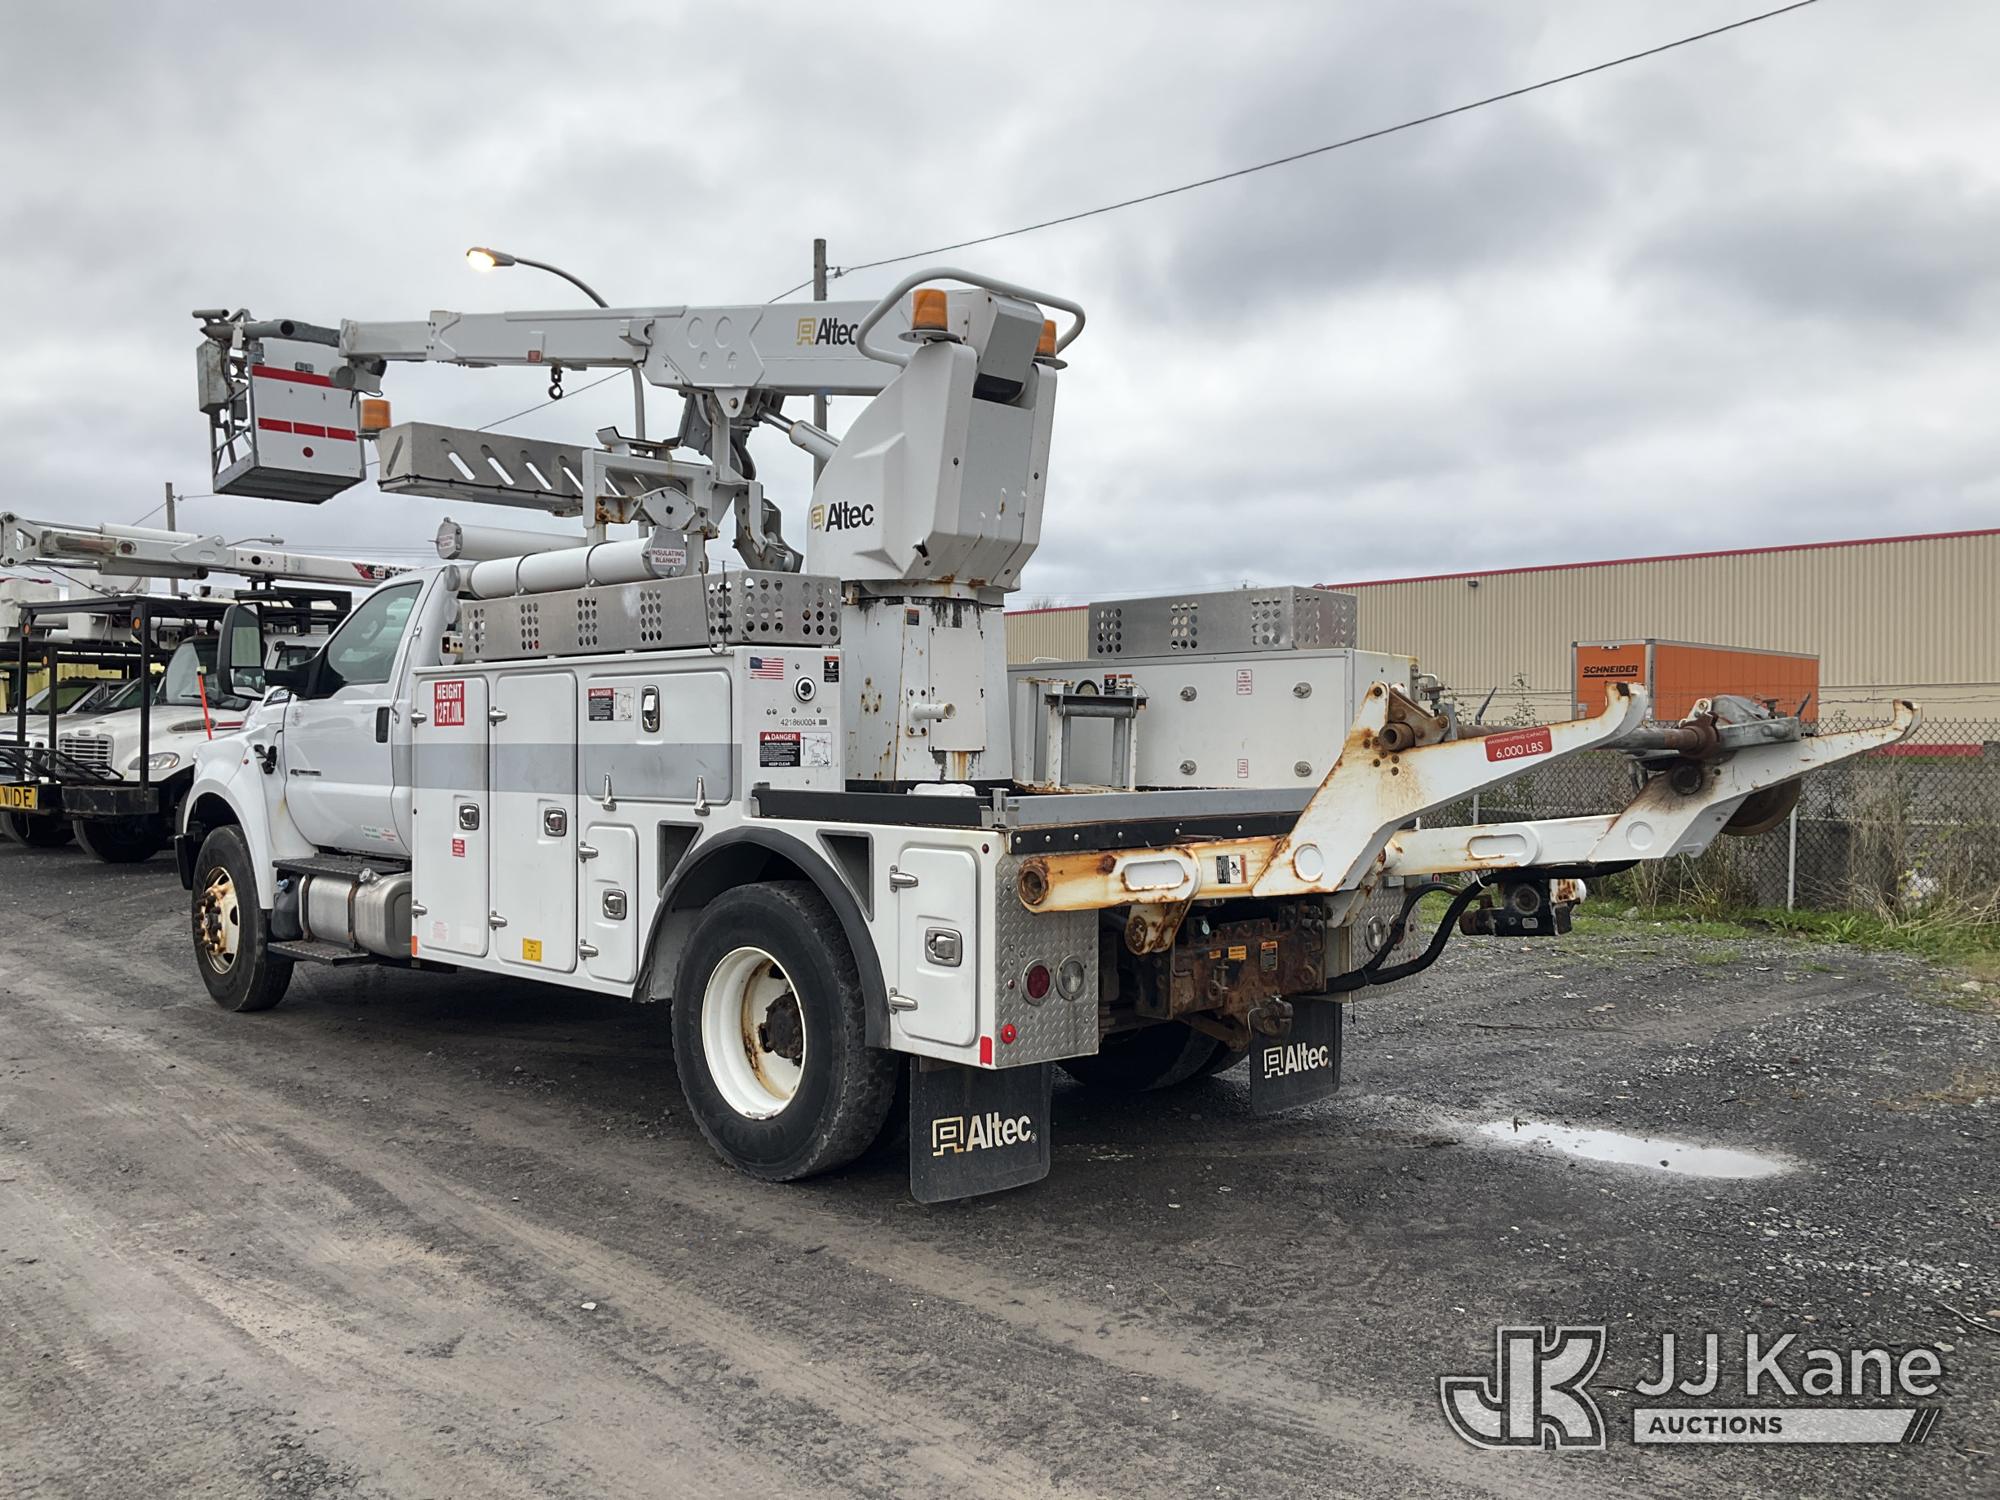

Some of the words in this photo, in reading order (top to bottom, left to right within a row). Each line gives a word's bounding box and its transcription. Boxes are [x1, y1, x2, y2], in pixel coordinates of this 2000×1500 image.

[815, 317, 858, 345] Altec
[825, 501, 874, 532] Altec
[1583, 665, 1638, 674] SCHNEIDER
[437, 683, 462, 699] HEIGHT
[770, 733, 797, 741] DANGER
[1525, 741, 1544, 754] LBS
[1284, 1042, 1329, 1075] Altec
[965, 1111, 1031, 1152] Altec
